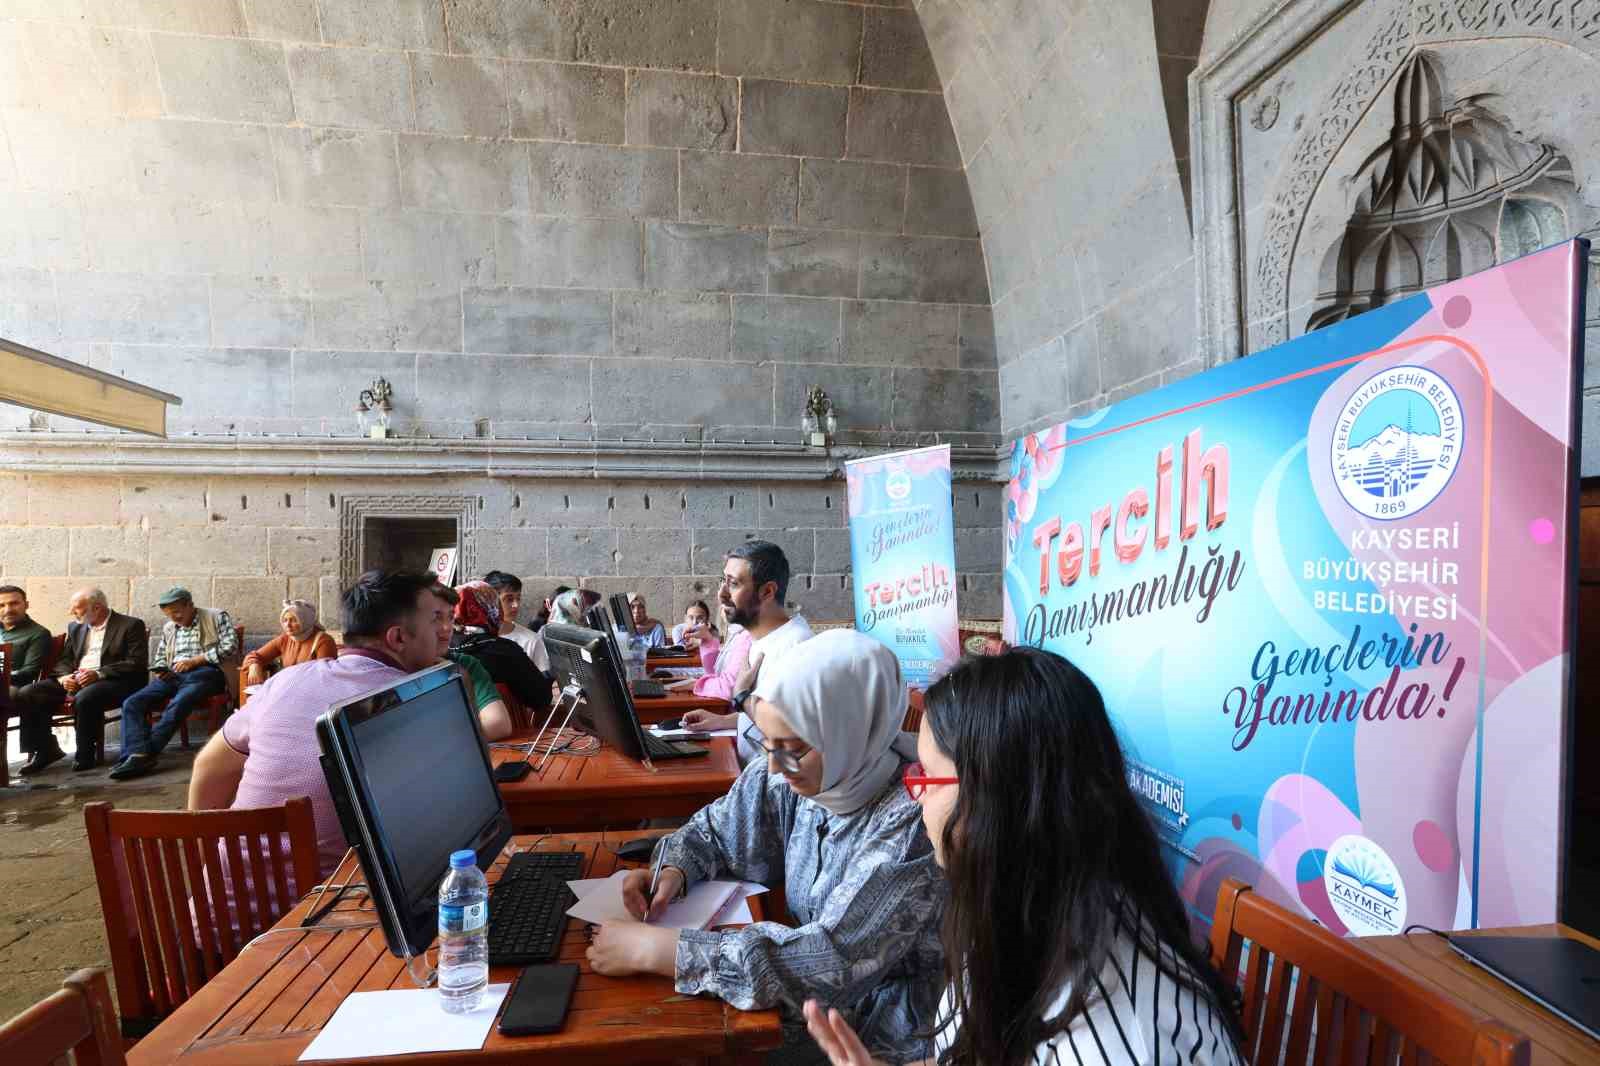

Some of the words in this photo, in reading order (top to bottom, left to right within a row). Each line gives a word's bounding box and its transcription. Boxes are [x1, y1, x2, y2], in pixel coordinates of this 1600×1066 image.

[1033, 427, 1230, 597] Tercih
[1375, 500, 1407, 515] 1869
[1351, 521, 1460, 550] KAYSERİ
[864, 561, 948, 608] Tercih
[1302, 556, 1459, 587] BÜYÜKŞEHİR
[1024, 543, 1246, 650] Danışmanlığı
[1312, 591, 1458, 621] BELEDİYESİ
[1250, 622, 1452, 702] Gençlerin
[1222, 656, 1466, 752] Yanında!
[1333, 882, 1393, 921] KAYMEK
